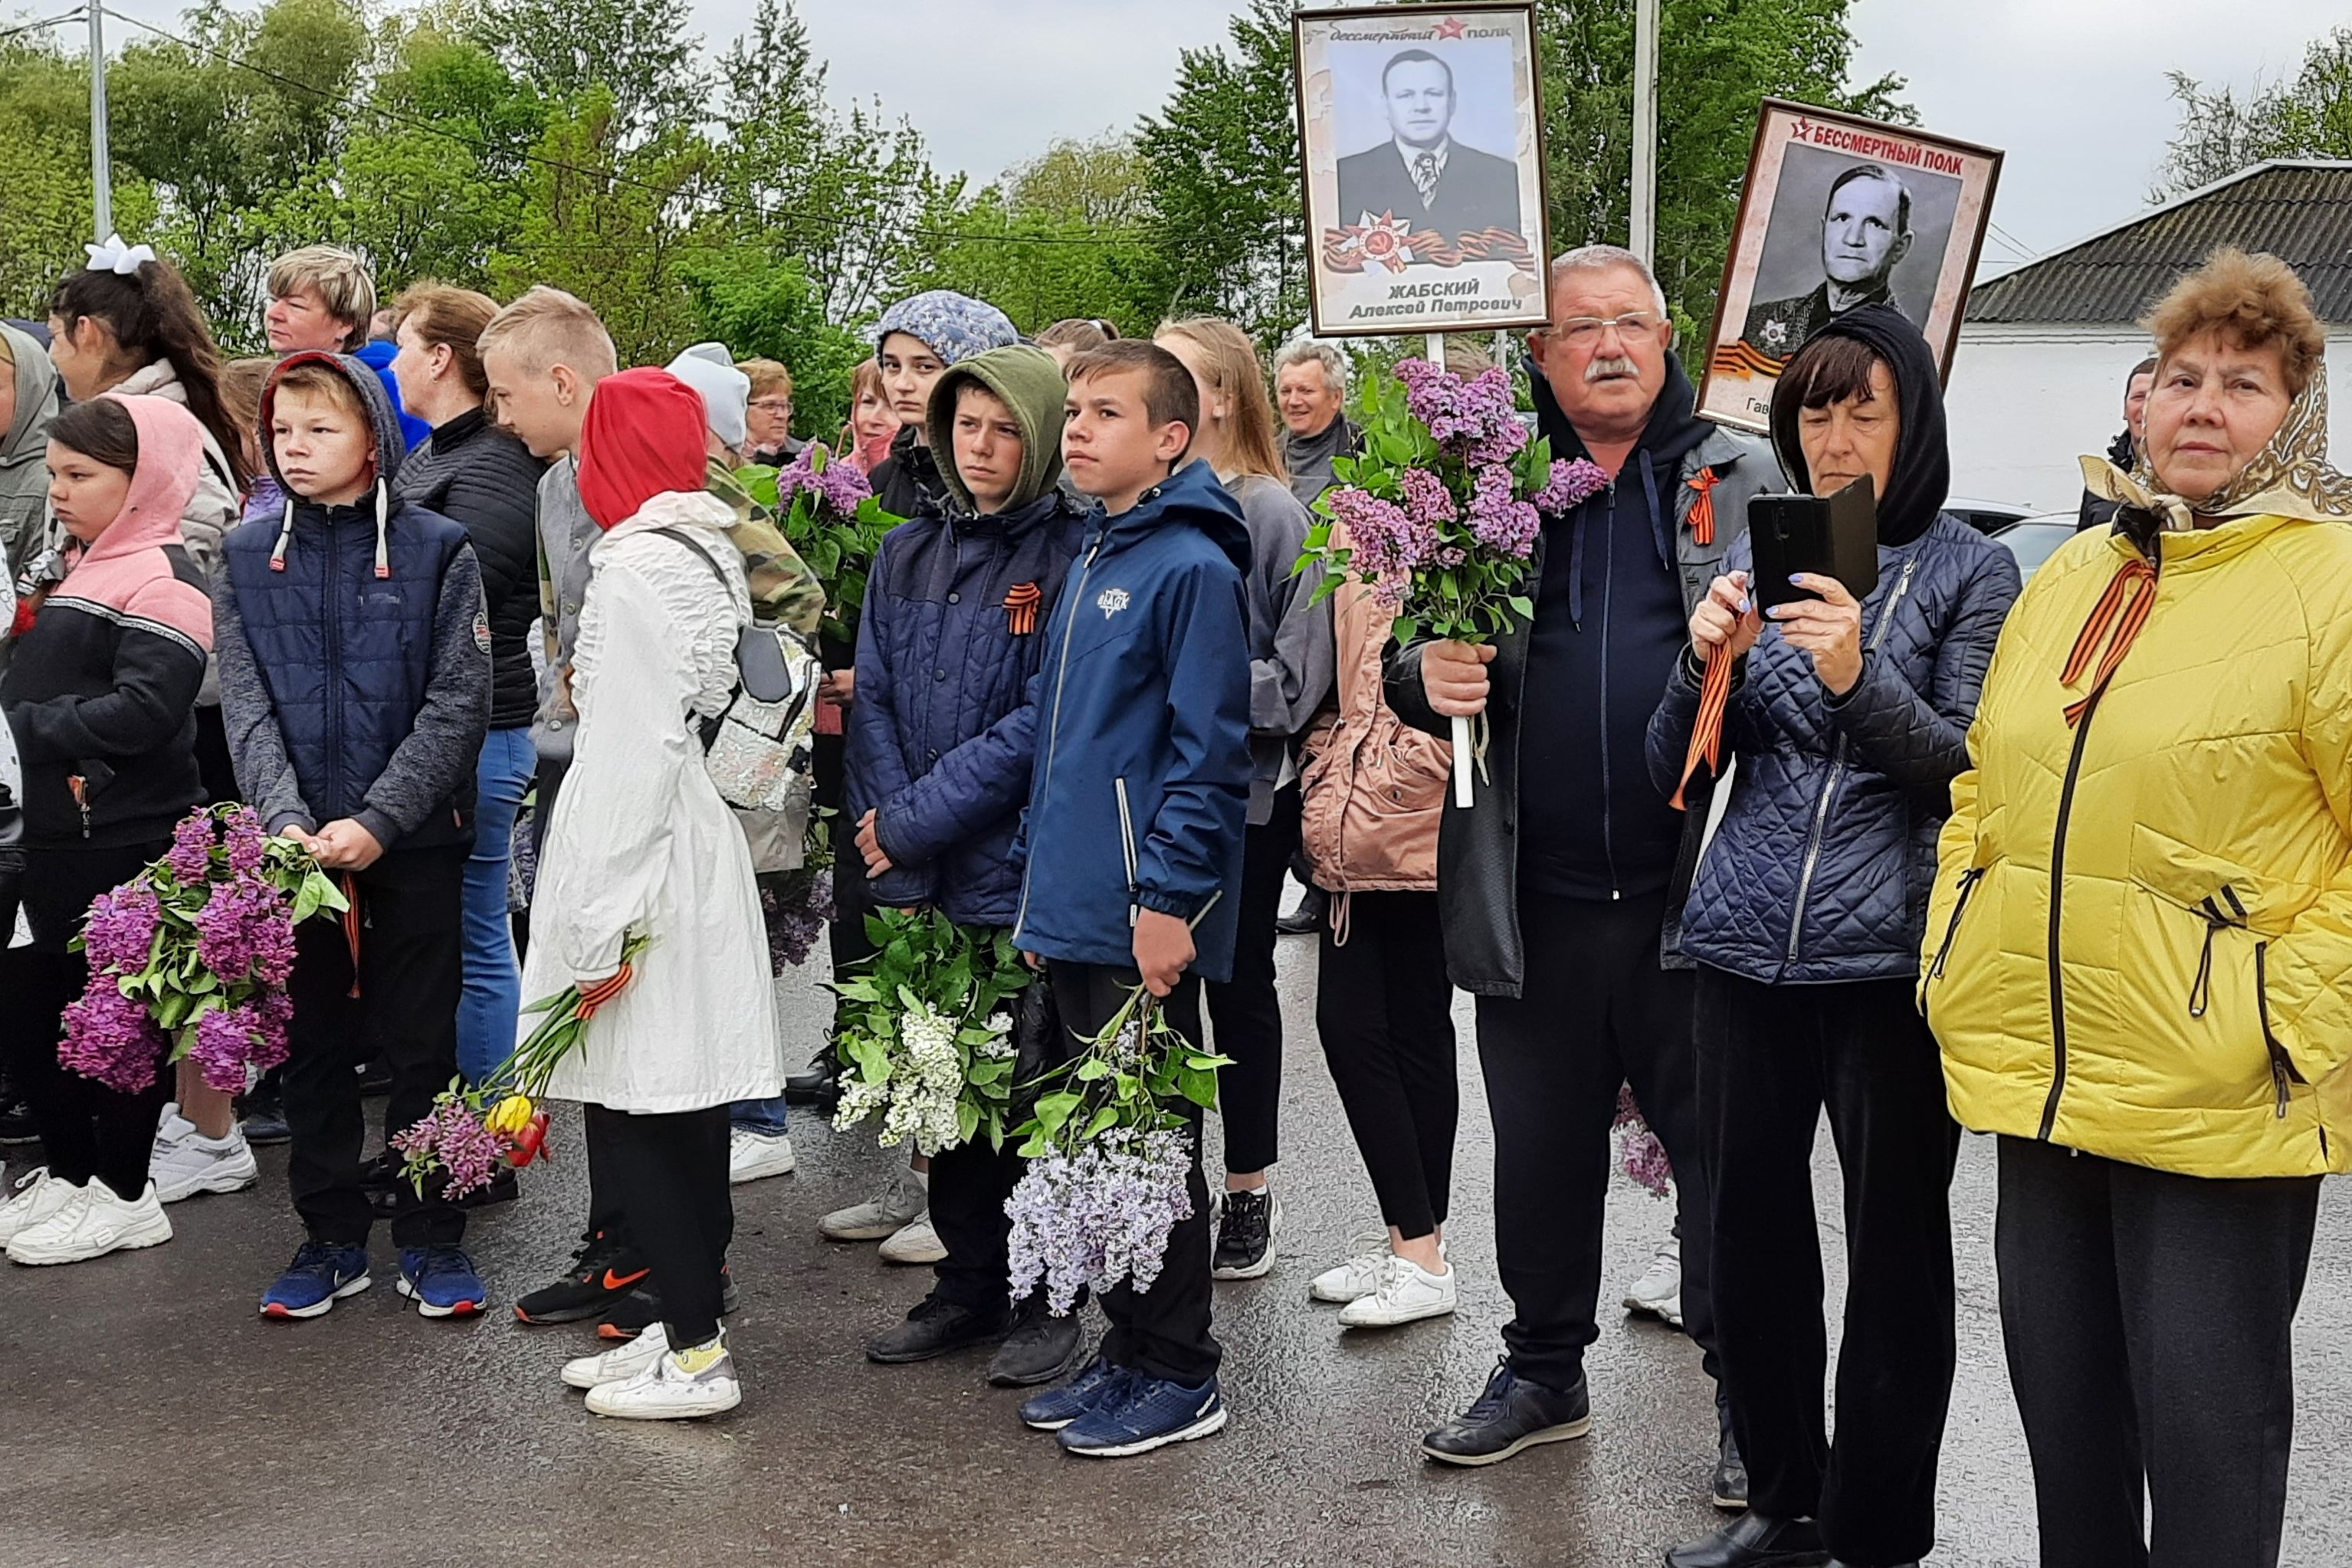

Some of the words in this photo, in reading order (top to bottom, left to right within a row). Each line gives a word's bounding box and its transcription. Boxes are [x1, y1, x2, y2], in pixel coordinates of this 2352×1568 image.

[1813, 126, 1922, 166] БЕССМЕРТНЫЙ
[1924, 149, 1964, 175] ПОЛК
[1388, 278, 1480, 300] ЖАБСКИЙ
[1349, 300, 1425, 320] Алексей
[1430, 297, 1523, 313] Петрович
[1747, 397, 1770, 415] Гав
